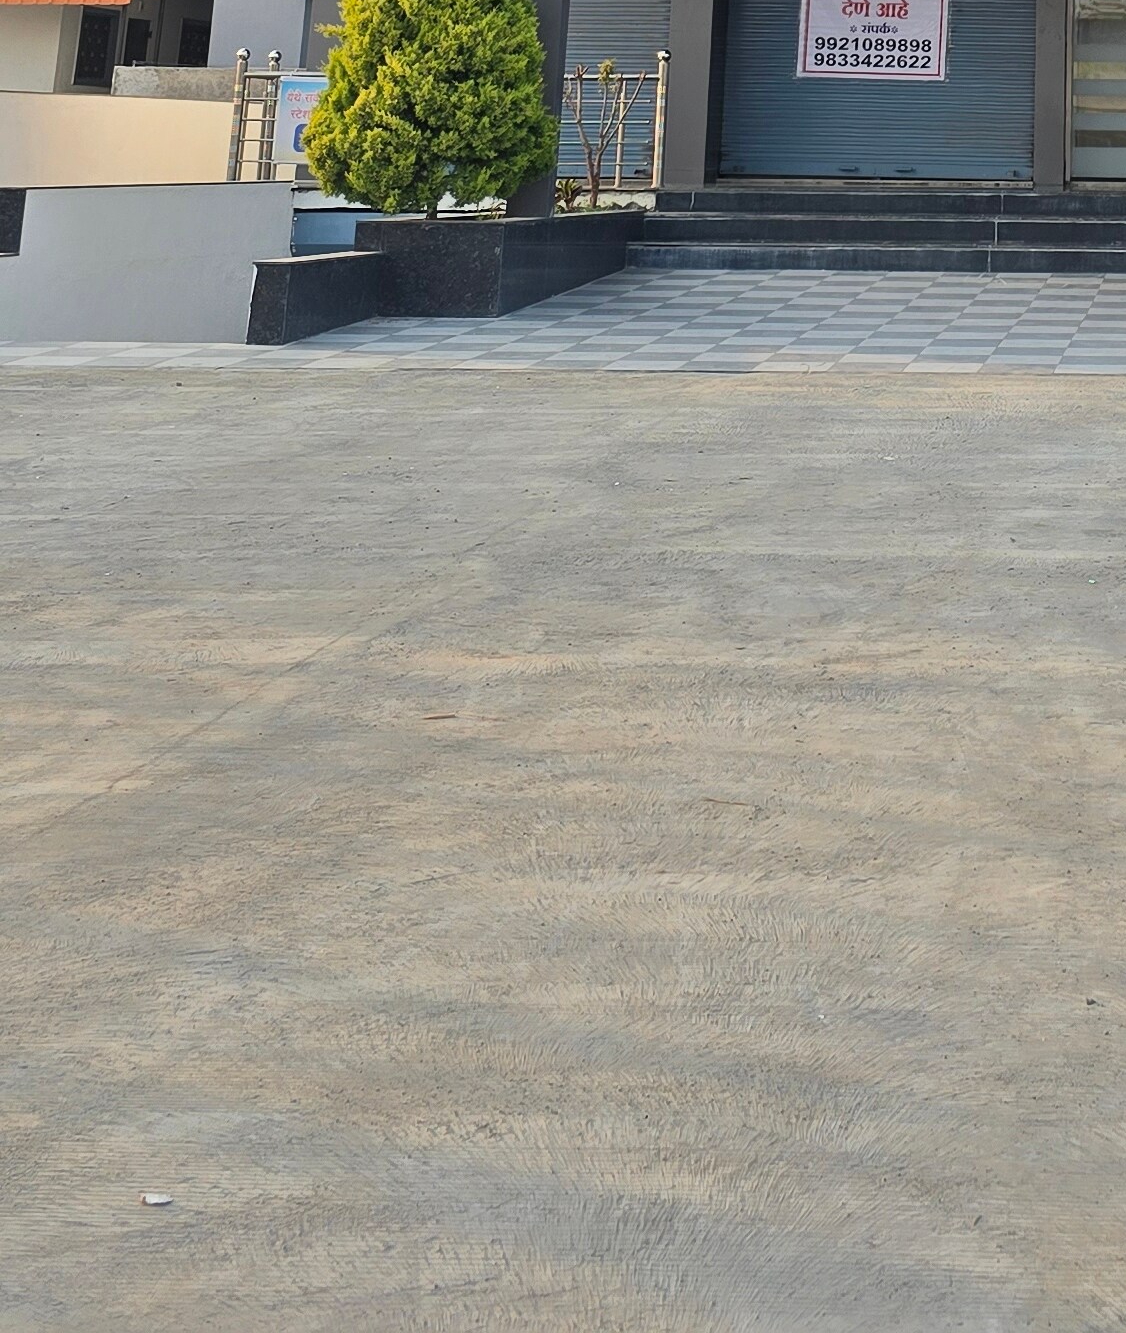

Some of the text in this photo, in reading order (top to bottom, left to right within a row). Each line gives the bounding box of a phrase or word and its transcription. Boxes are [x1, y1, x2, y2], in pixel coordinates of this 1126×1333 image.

[861, 22, 891, 34] संपर्क
[814, 36, 932, 53] 9921089898
[813, 53, 932, 69] 9833422622
